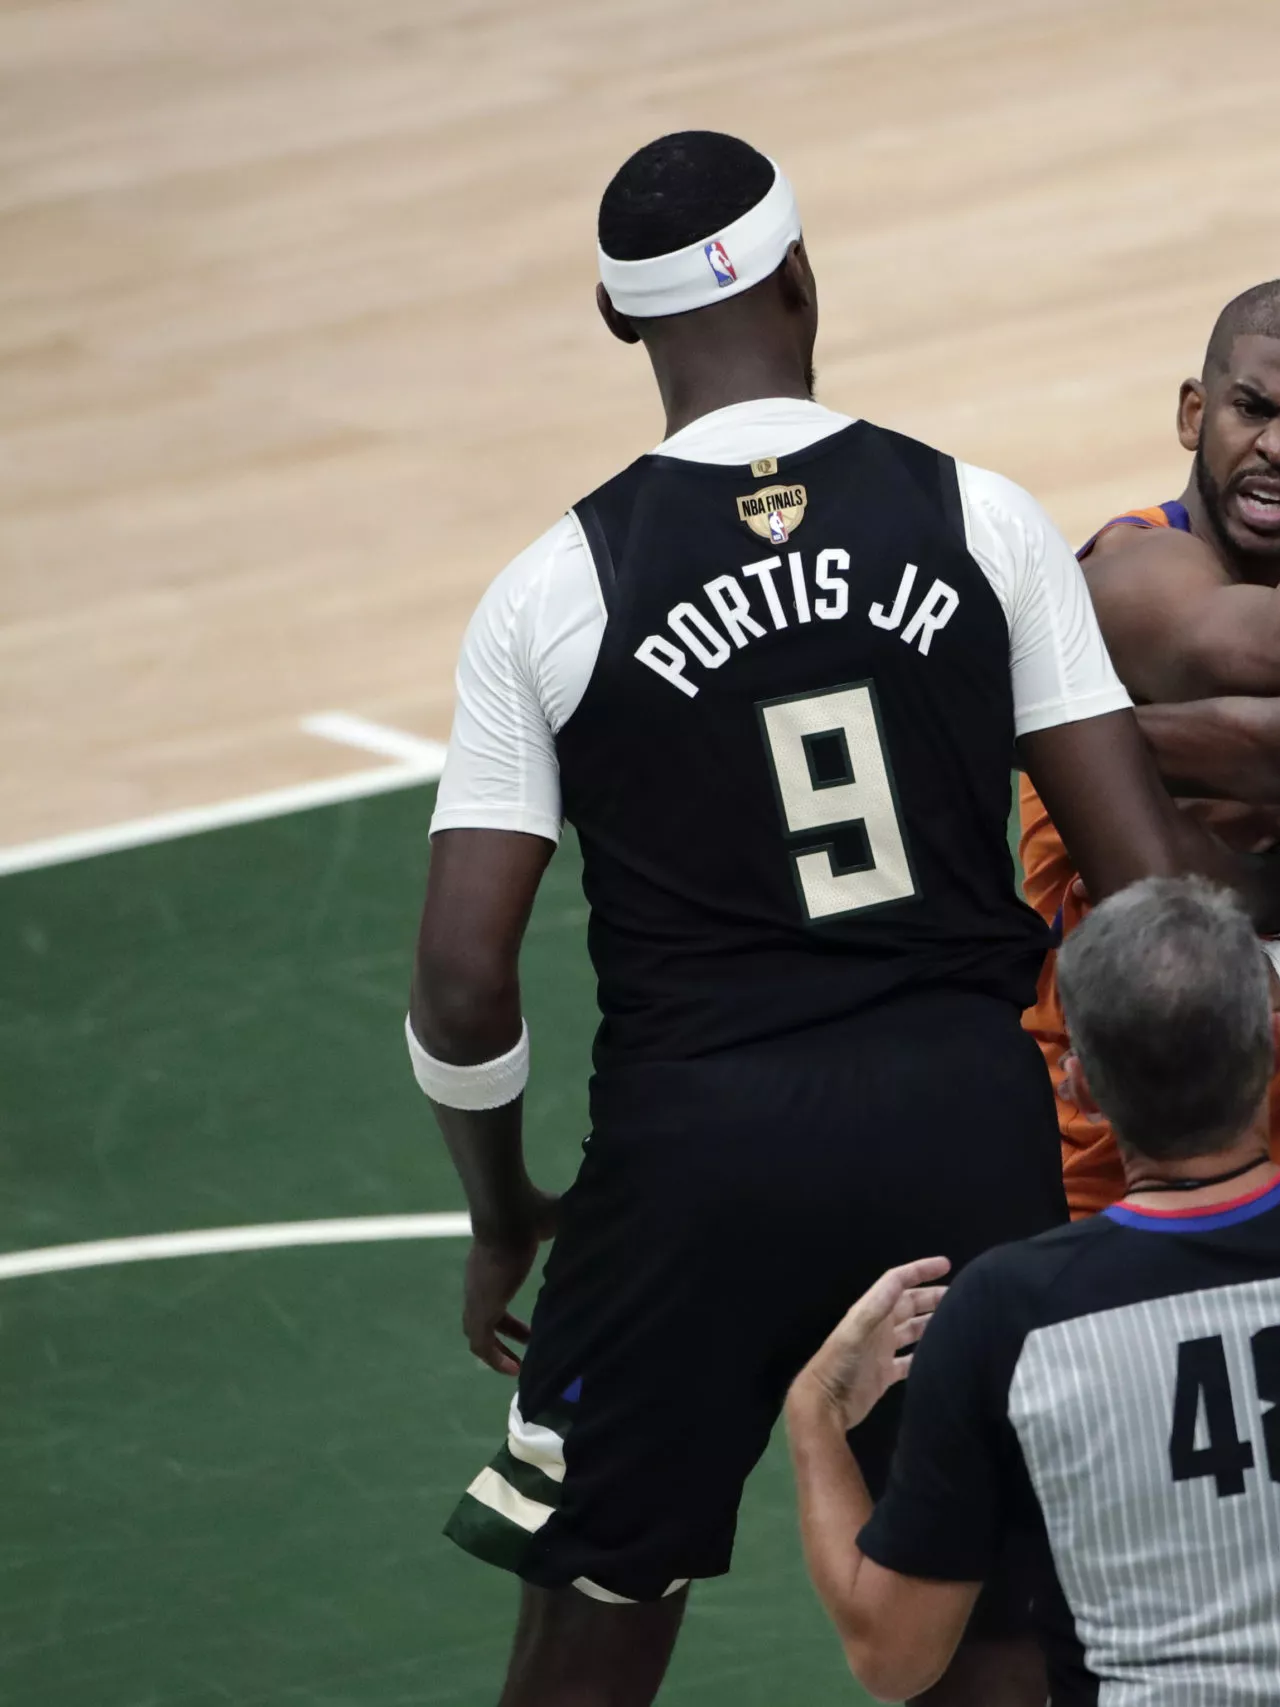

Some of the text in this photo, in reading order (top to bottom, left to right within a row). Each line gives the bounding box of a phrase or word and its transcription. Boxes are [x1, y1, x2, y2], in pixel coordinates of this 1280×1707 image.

[741, 489, 803, 517] NBA FINALS
[634, 548, 959, 698] PORTIS JR
[759, 684, 918, 922] 9
